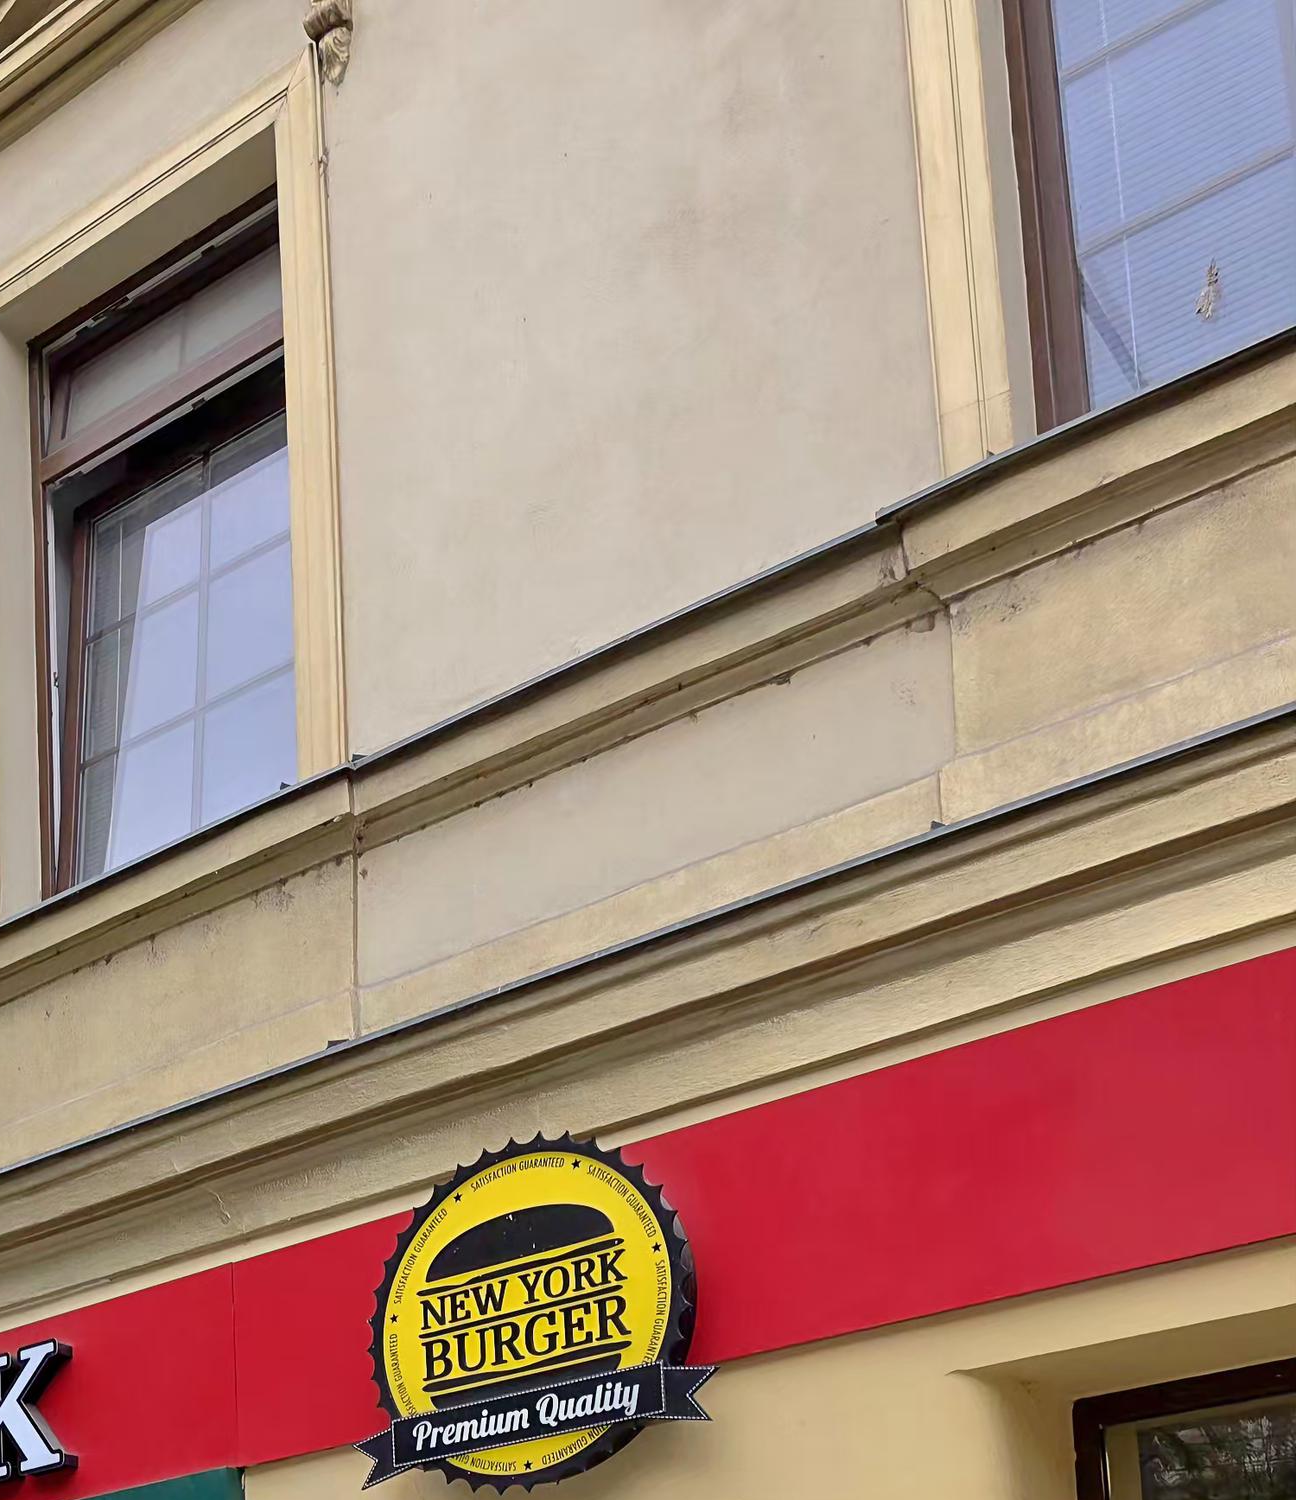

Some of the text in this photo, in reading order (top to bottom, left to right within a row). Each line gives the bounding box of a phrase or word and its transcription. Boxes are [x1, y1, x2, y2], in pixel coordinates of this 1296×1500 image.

[470, 1156, 565, 1193] SATISFACTION GUARANTEED
[586, 1164, 658, 1238] SATISFACTION GUARANTEED
[394, 1207, 449, 1304] SATISFACTION GUARANTEED
[419, 1248, 628, 1331] NEW YORK
[655, 1259, 668, 1316] SATISFACTION
[388, 1333, 403, 1382] GUARANTEED
[421, 1295, 632, 1382] BURGER
[411, 1379, 640, 1451] Premium Quality
